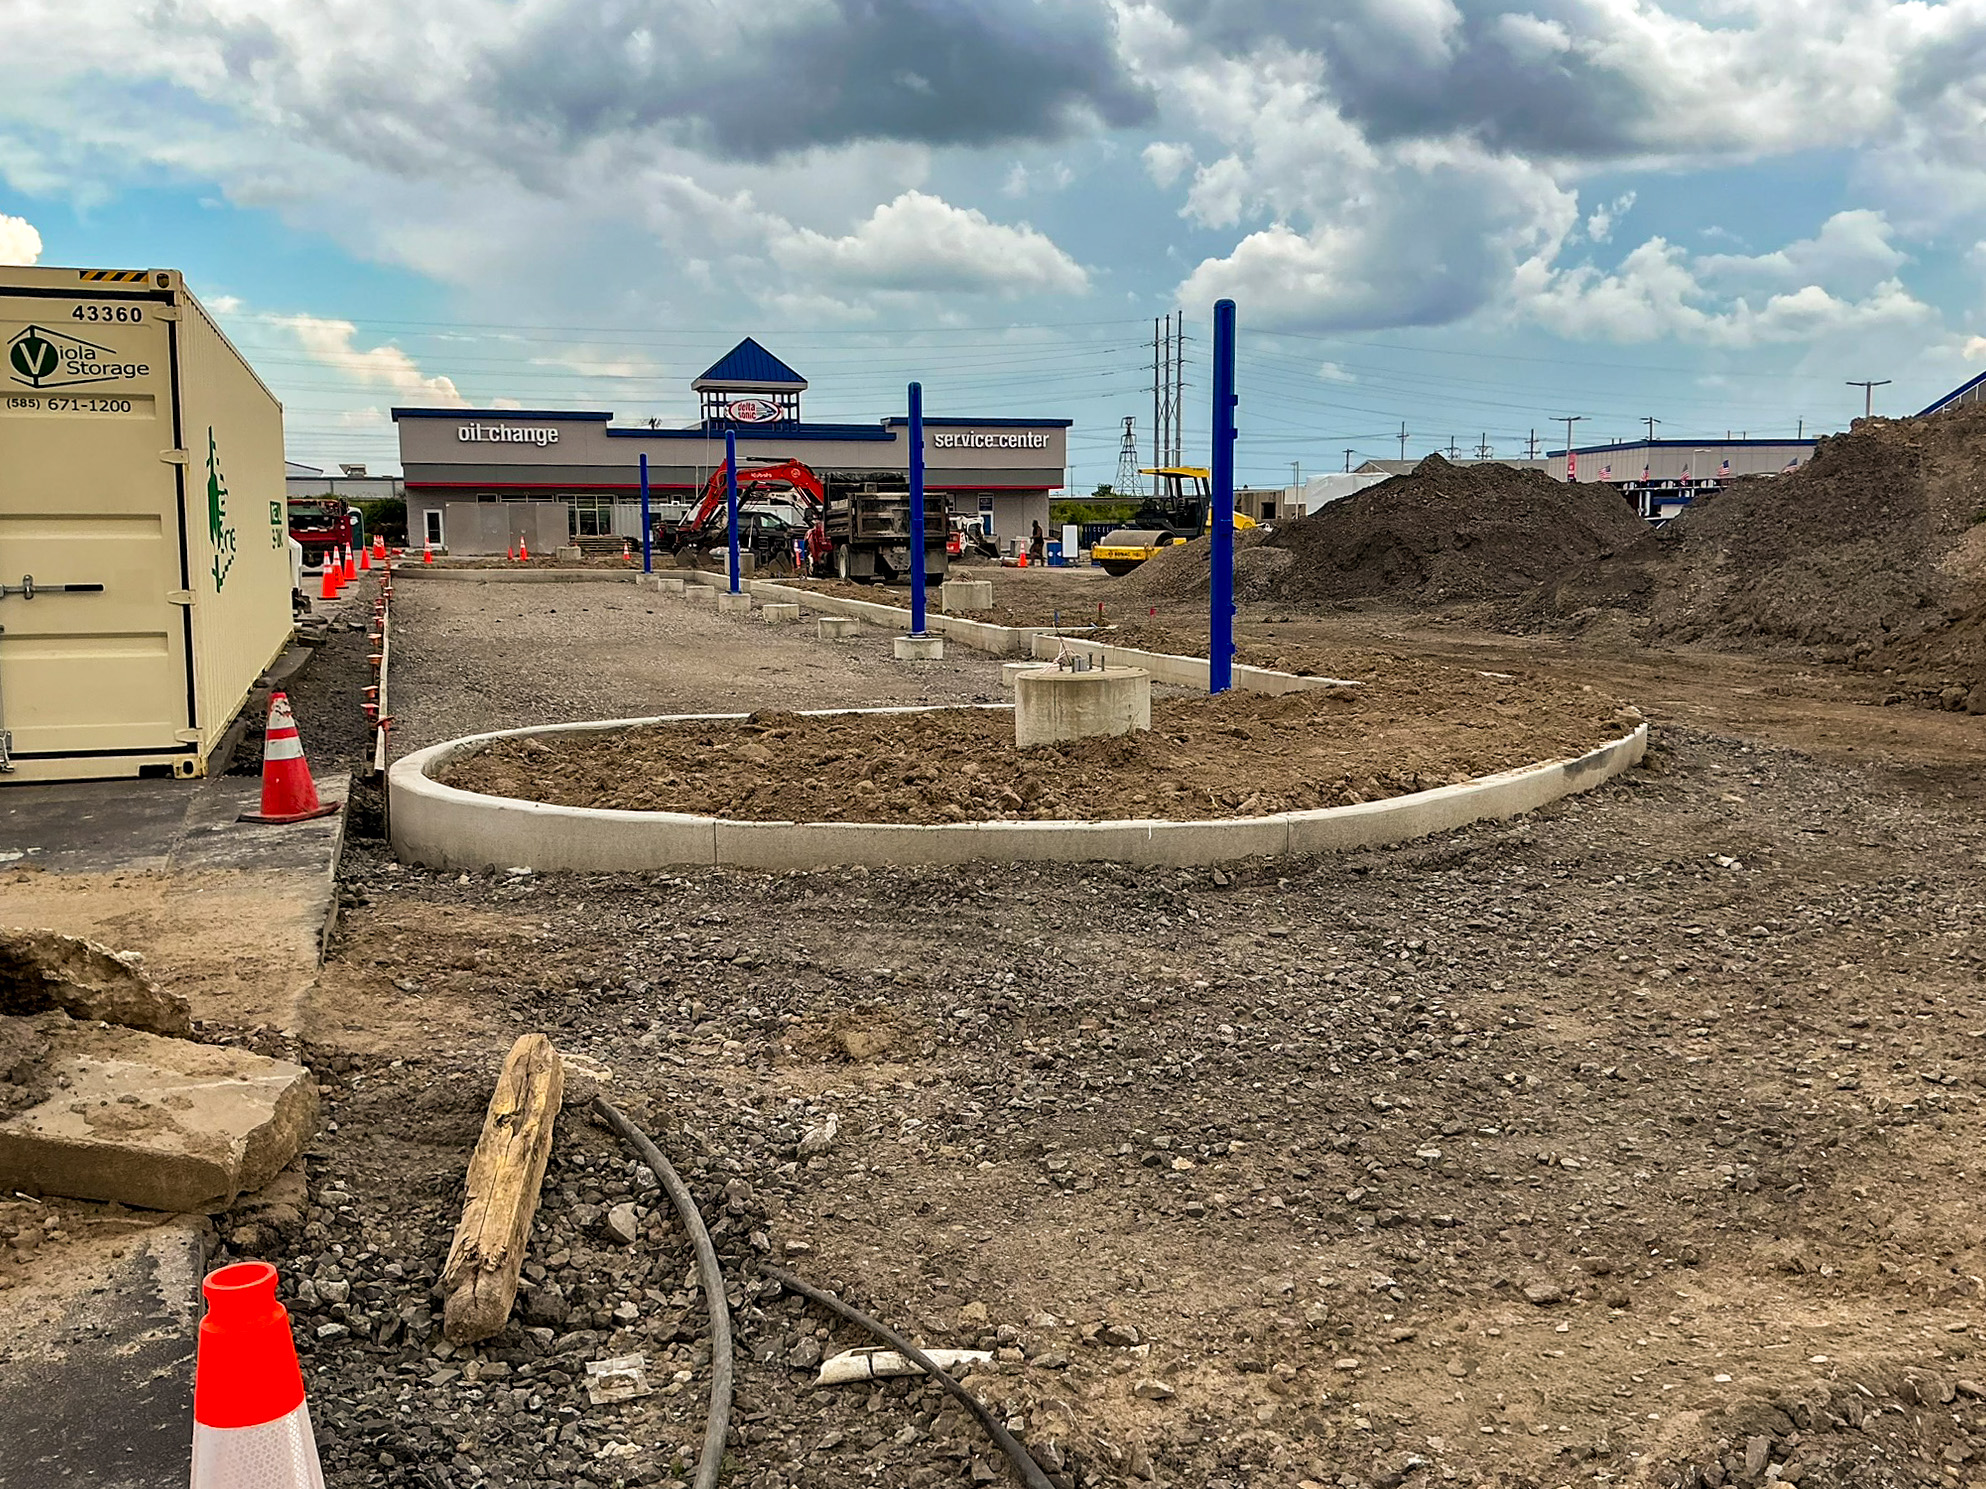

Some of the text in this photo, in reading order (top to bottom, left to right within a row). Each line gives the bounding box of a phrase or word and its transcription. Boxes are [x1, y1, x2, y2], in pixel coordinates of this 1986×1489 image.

[72, 305, 142, 323] 43360
[18, 342, 96, 375] Viola
[66, 361, 150, 379] Storage
[6, 398, 131, 413] (585) 671-1200
[737, 403, 756, 412] delta
[737, 411, 757, 420] sonic
[458, 422, 559, 447] oil change
[934, 430, 1050, 448] service center
